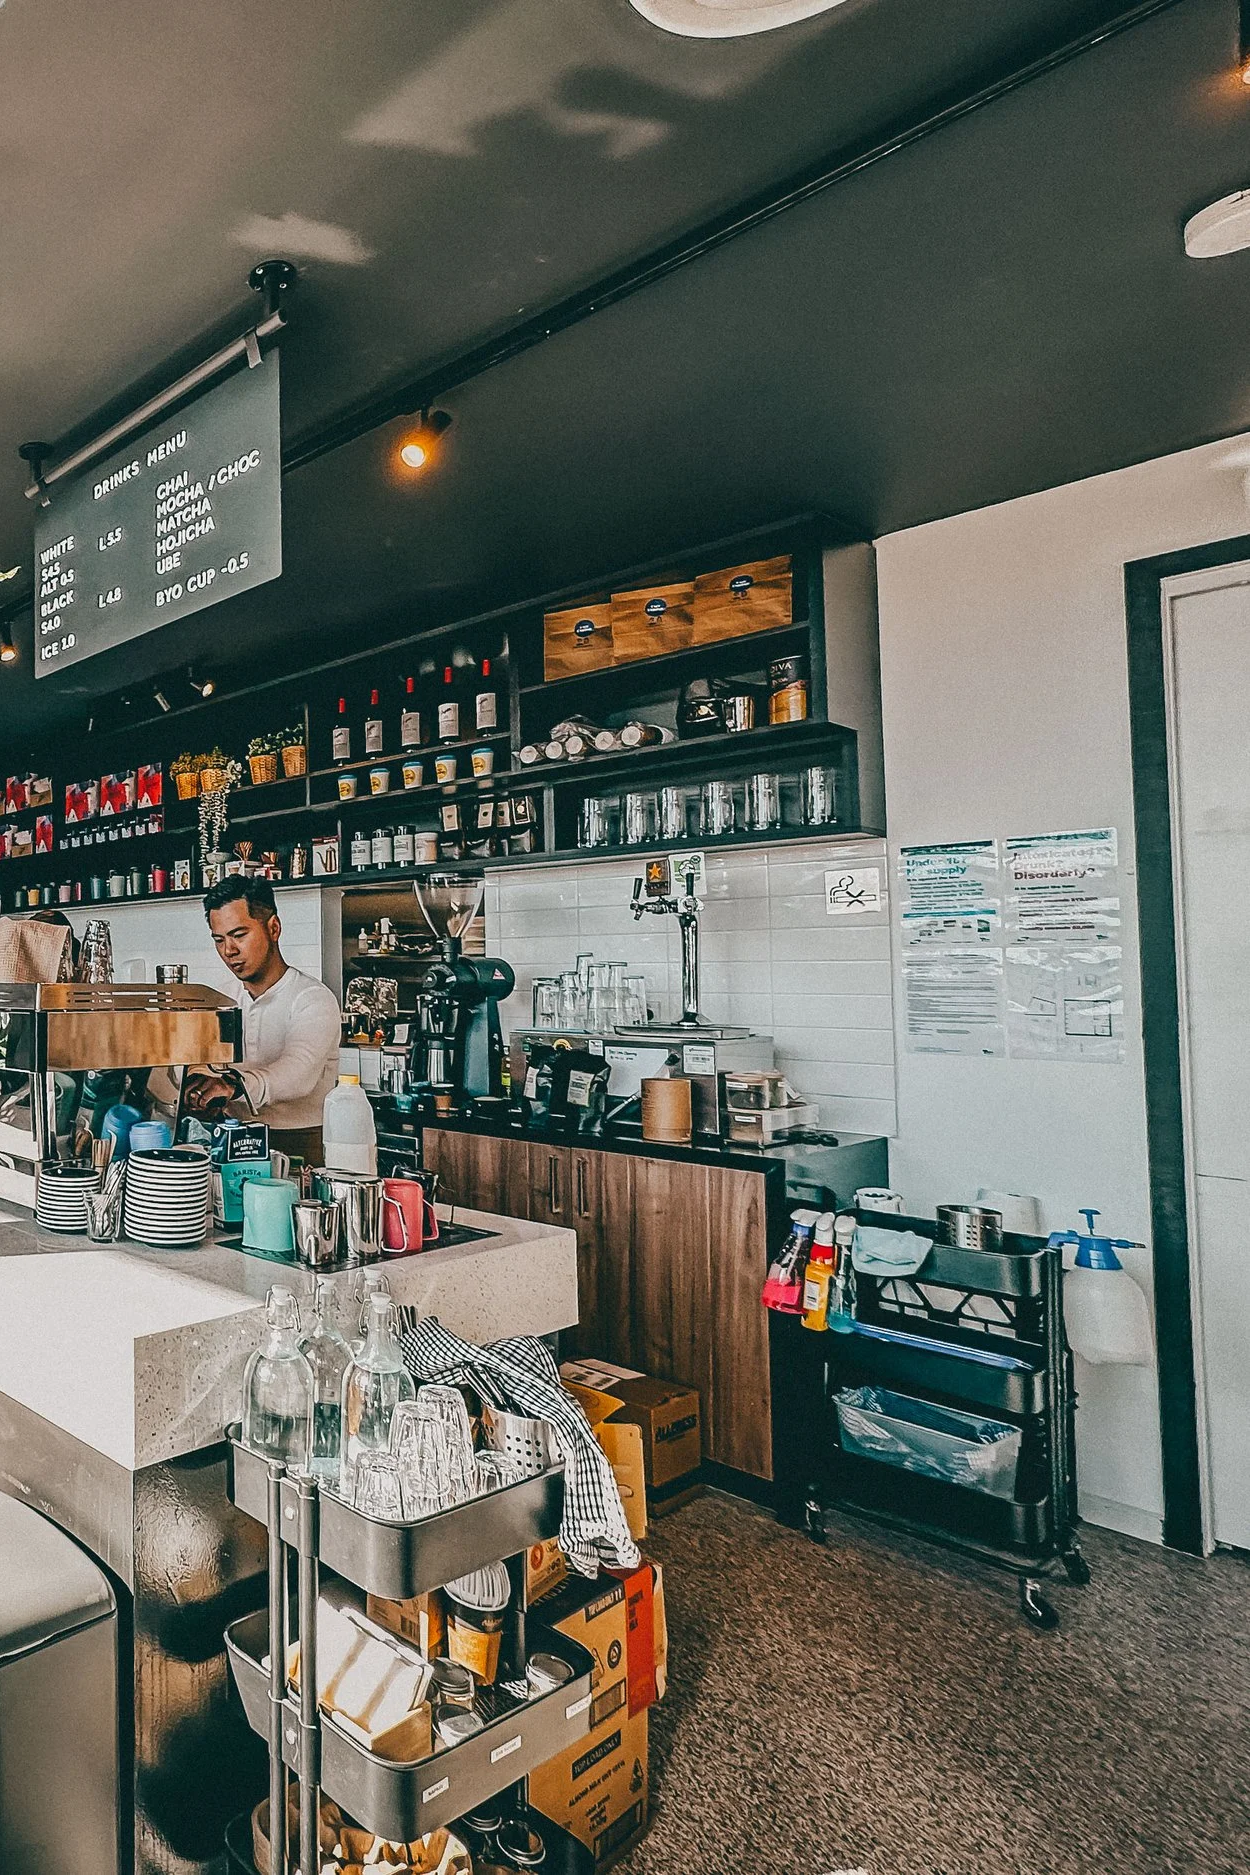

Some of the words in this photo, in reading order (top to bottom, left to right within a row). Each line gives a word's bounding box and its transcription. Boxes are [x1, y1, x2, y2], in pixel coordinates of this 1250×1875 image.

[93, 461, 140, 500] DRINKS
[147, 430, 187, 467] MENU
[156, 470, 188, 500] CHAI
[156, 482, 204, 519] MOCHA
[156, 497, 211, 537] MATCHA
[40, 535, 75, 565] WHITE
[156, 516, 216, 556] HOJICHA
[156, 551, 181, 575] UBE
[40, 577, 59, 598] ALT
[155, 583, 182, 607] BYO
[186, 568, 216, 593] CUP
[40, 589, 74, 617] BLACK
[41, 642, 59, 660] ICE
